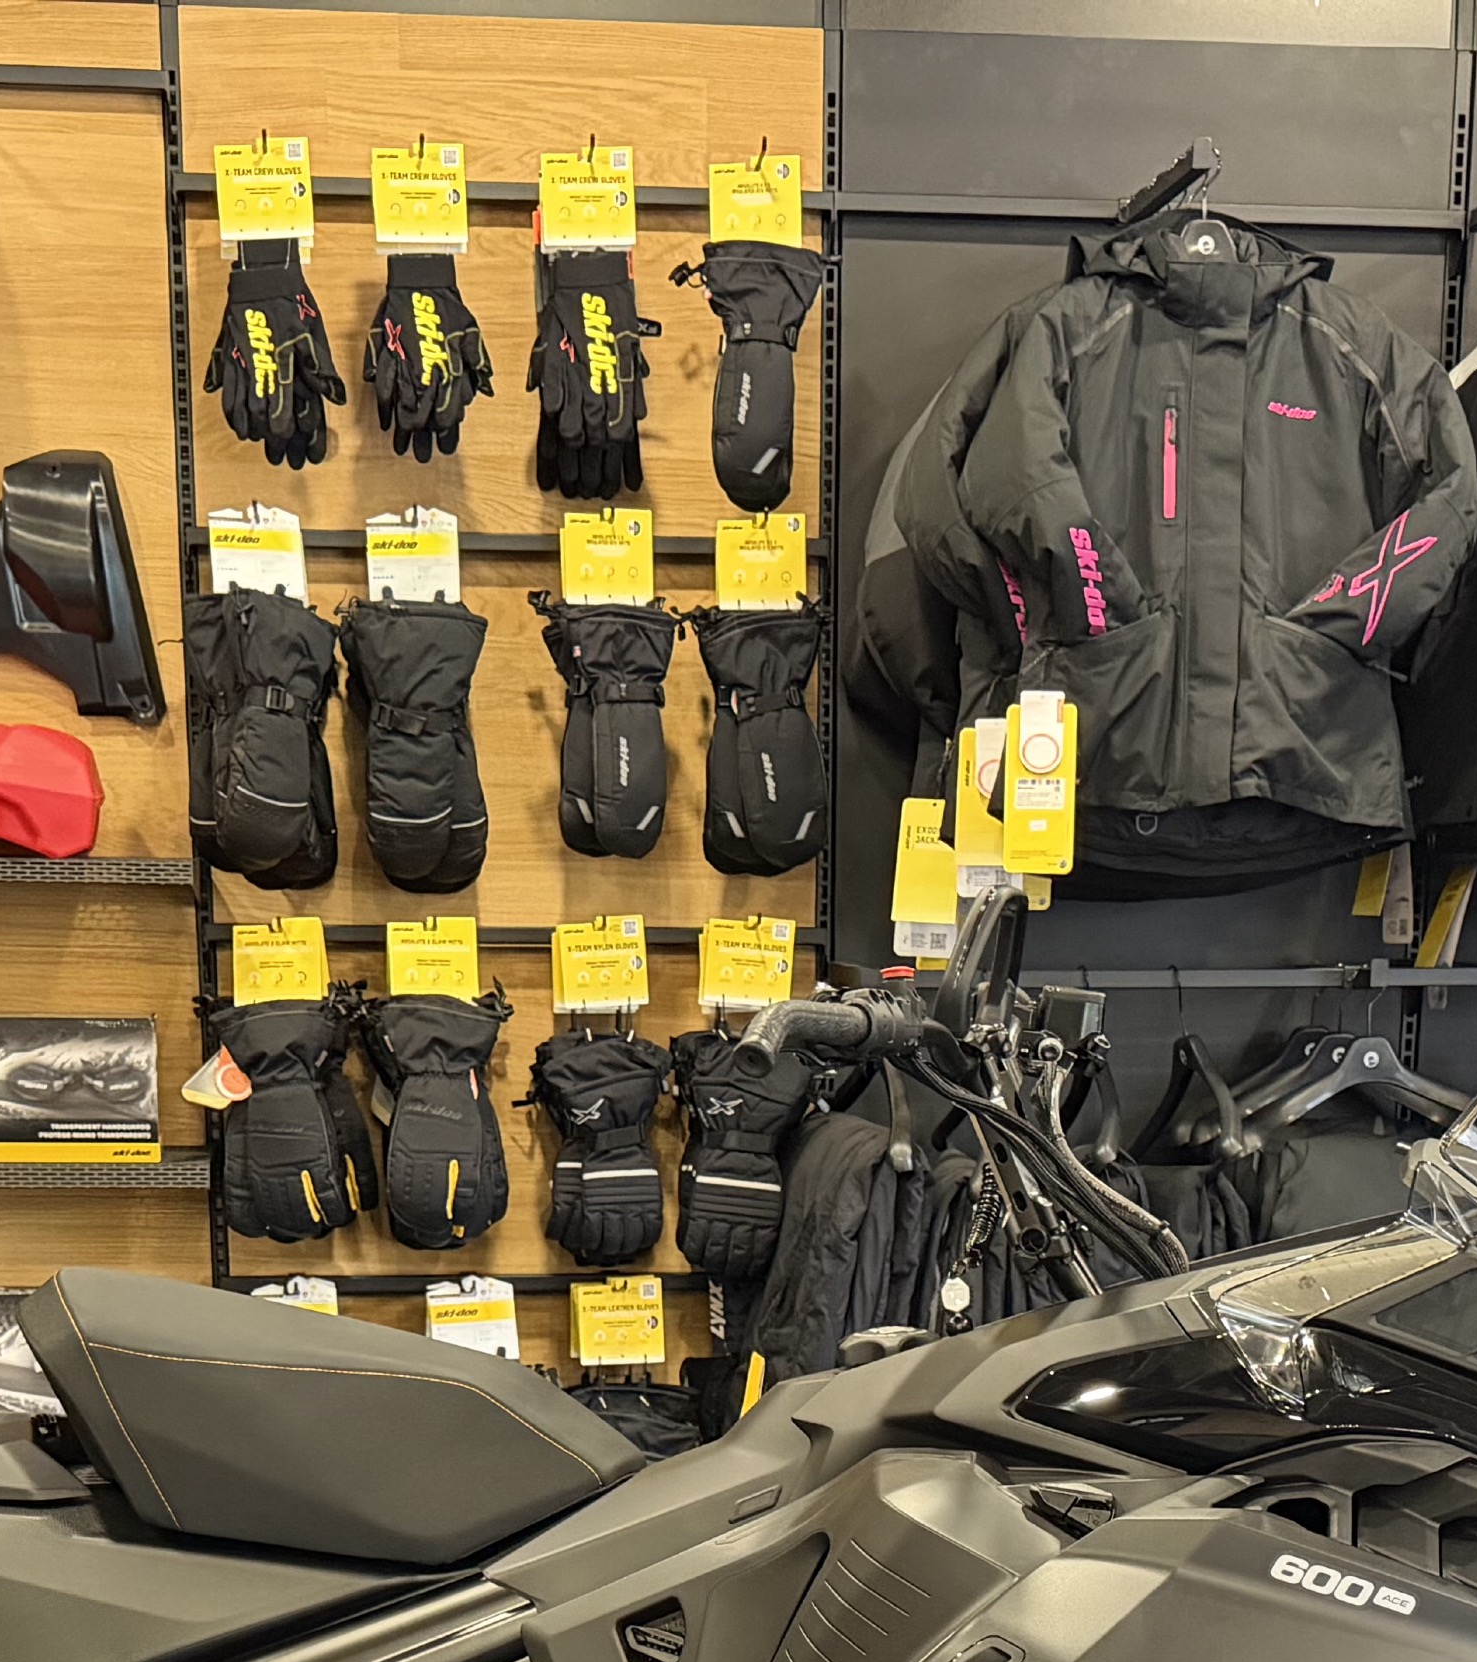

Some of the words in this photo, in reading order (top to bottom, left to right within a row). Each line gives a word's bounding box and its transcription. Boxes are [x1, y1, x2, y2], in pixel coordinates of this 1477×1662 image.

[254, 167, 274, 176] CREW
[275, 167, 302, 175] GLOVES
[410, 172, 430, 181] CREW
[431, 173, 457, 181] GLOVES
[600, 175, 626, 184] GLOVES
[1267, 401, 1317, 421] ski-doo
[214, 534, 260, 544] ski-doo
[372, 540, 418, 550] ski-doo
[435, 1306, 479, 1320] ski-doo
[708, 1278, 726, 1339] LYNX
[1270, 1554, 1375, 1606] 600
[1382, 1594, 1410, 1608] ACE
